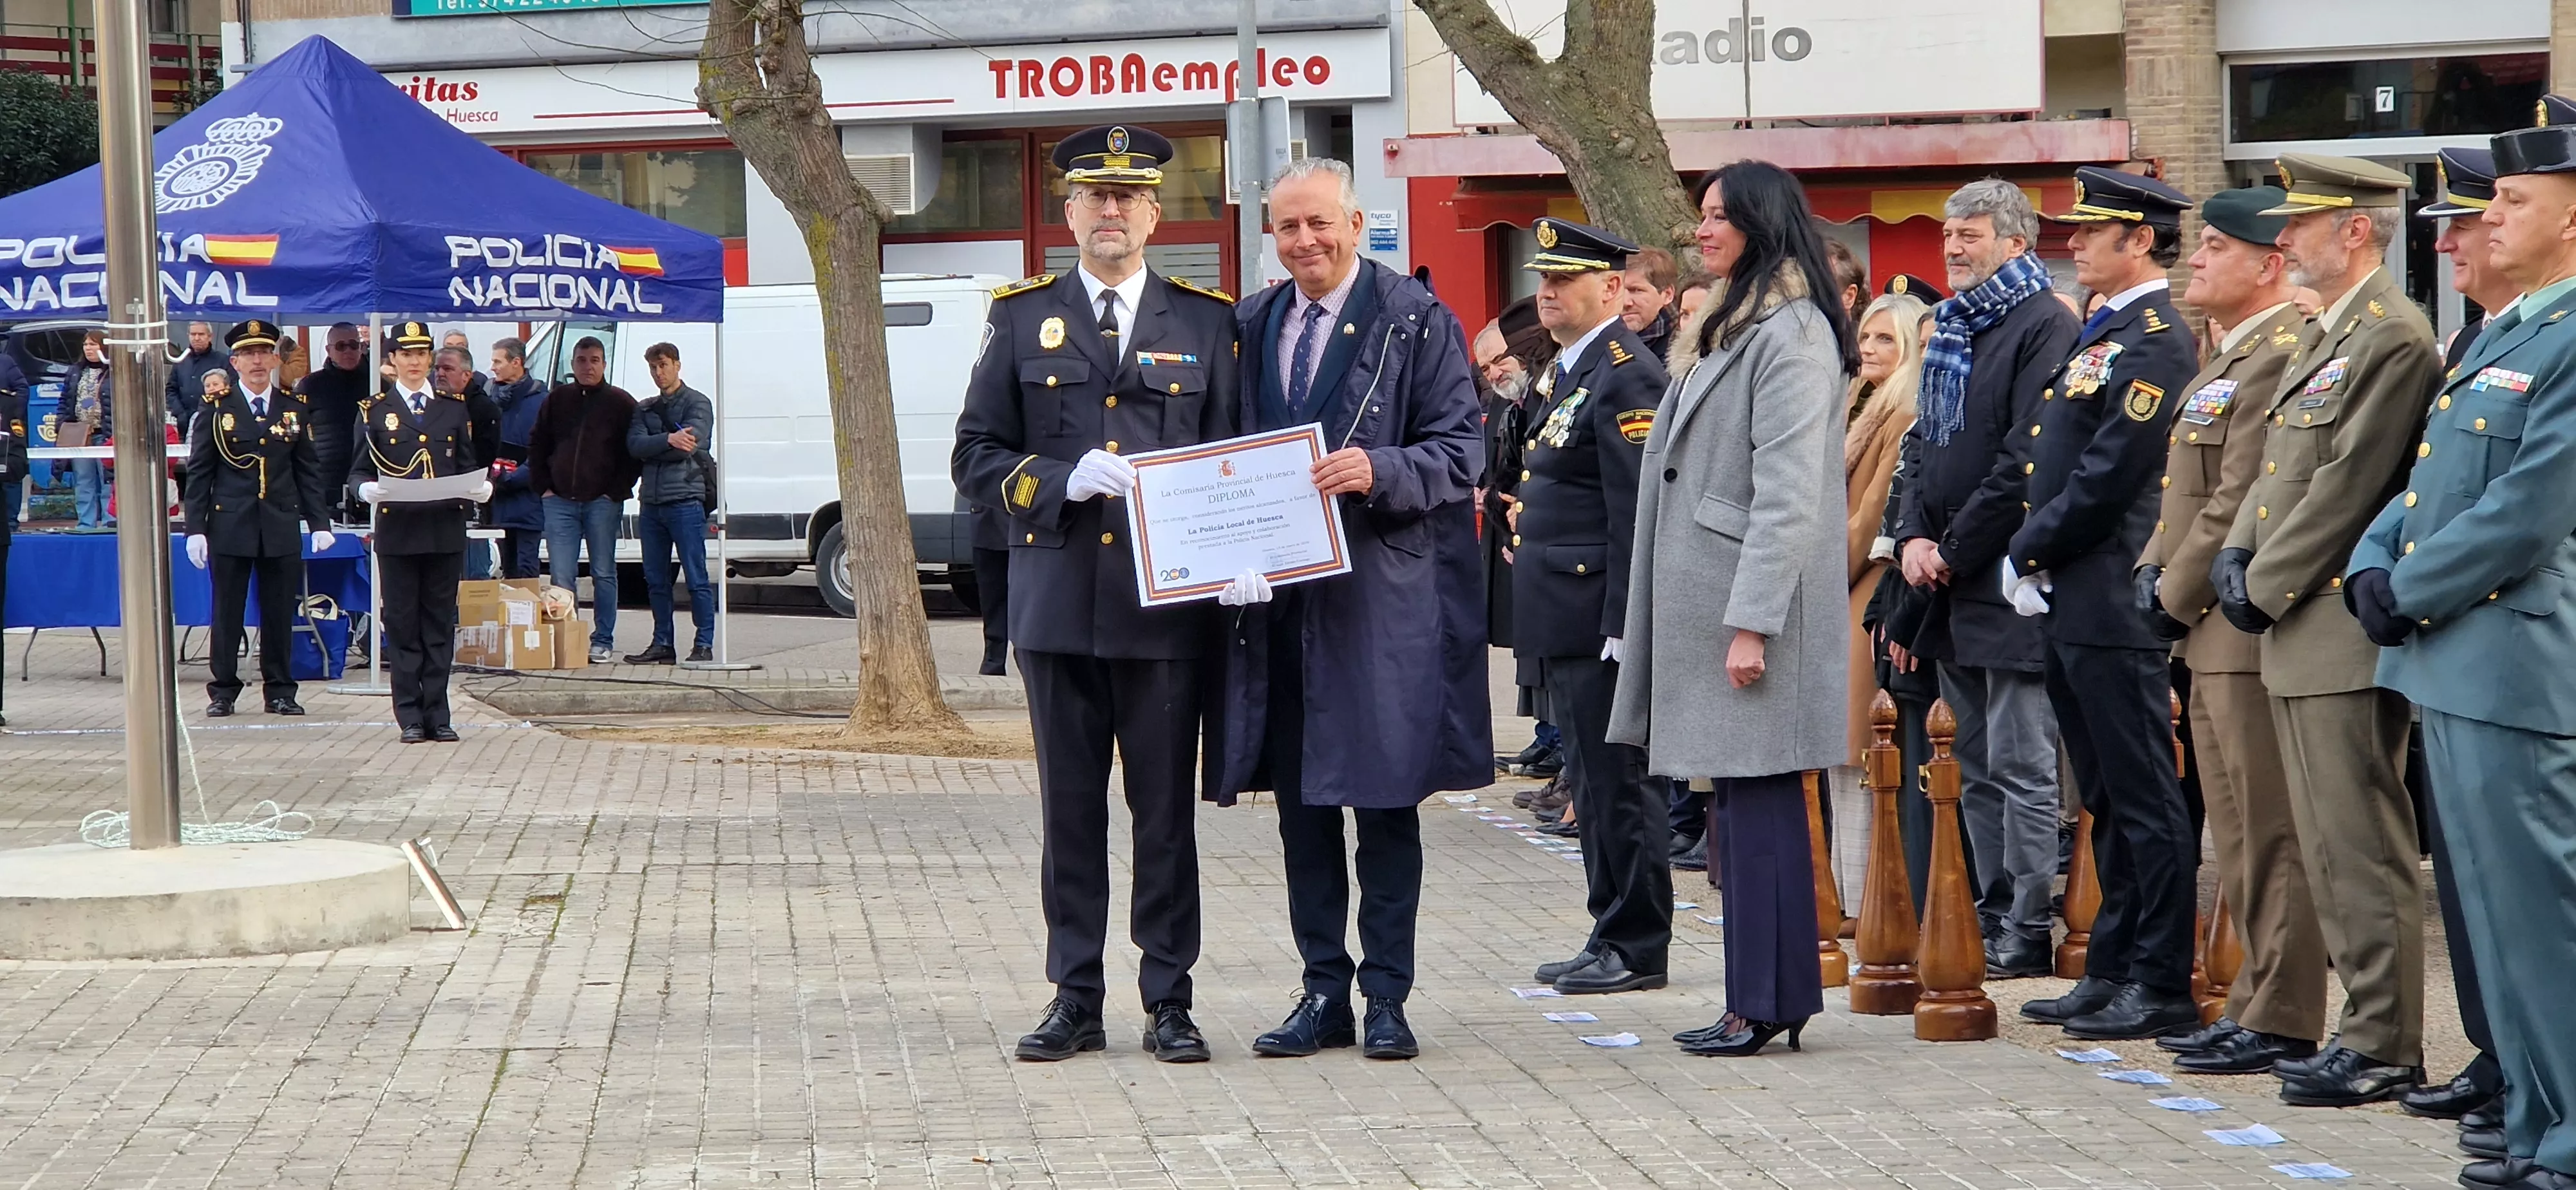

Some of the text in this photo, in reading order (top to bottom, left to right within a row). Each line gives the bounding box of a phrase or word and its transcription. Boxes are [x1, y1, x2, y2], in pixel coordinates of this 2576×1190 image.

[1651, 16, 1812, 65] adio
[2379, 90, 2392, 108] 7
[446, 108, 498, 122] Huesca
[0, 270, 278, 311] NACINAL
[448, 272, 663, 314] NACIONAL
[1173, 484, 1214, 495] Comisaría
[1217, 476, 1253, 489] Provincial
[1266, 470, 1295, 479] Huesca
[1208, 488, 1255, 503] DIPLOMA
[1226, 520, 1244, 528] Local
[1256, 515, 1283, 523] Huesca
